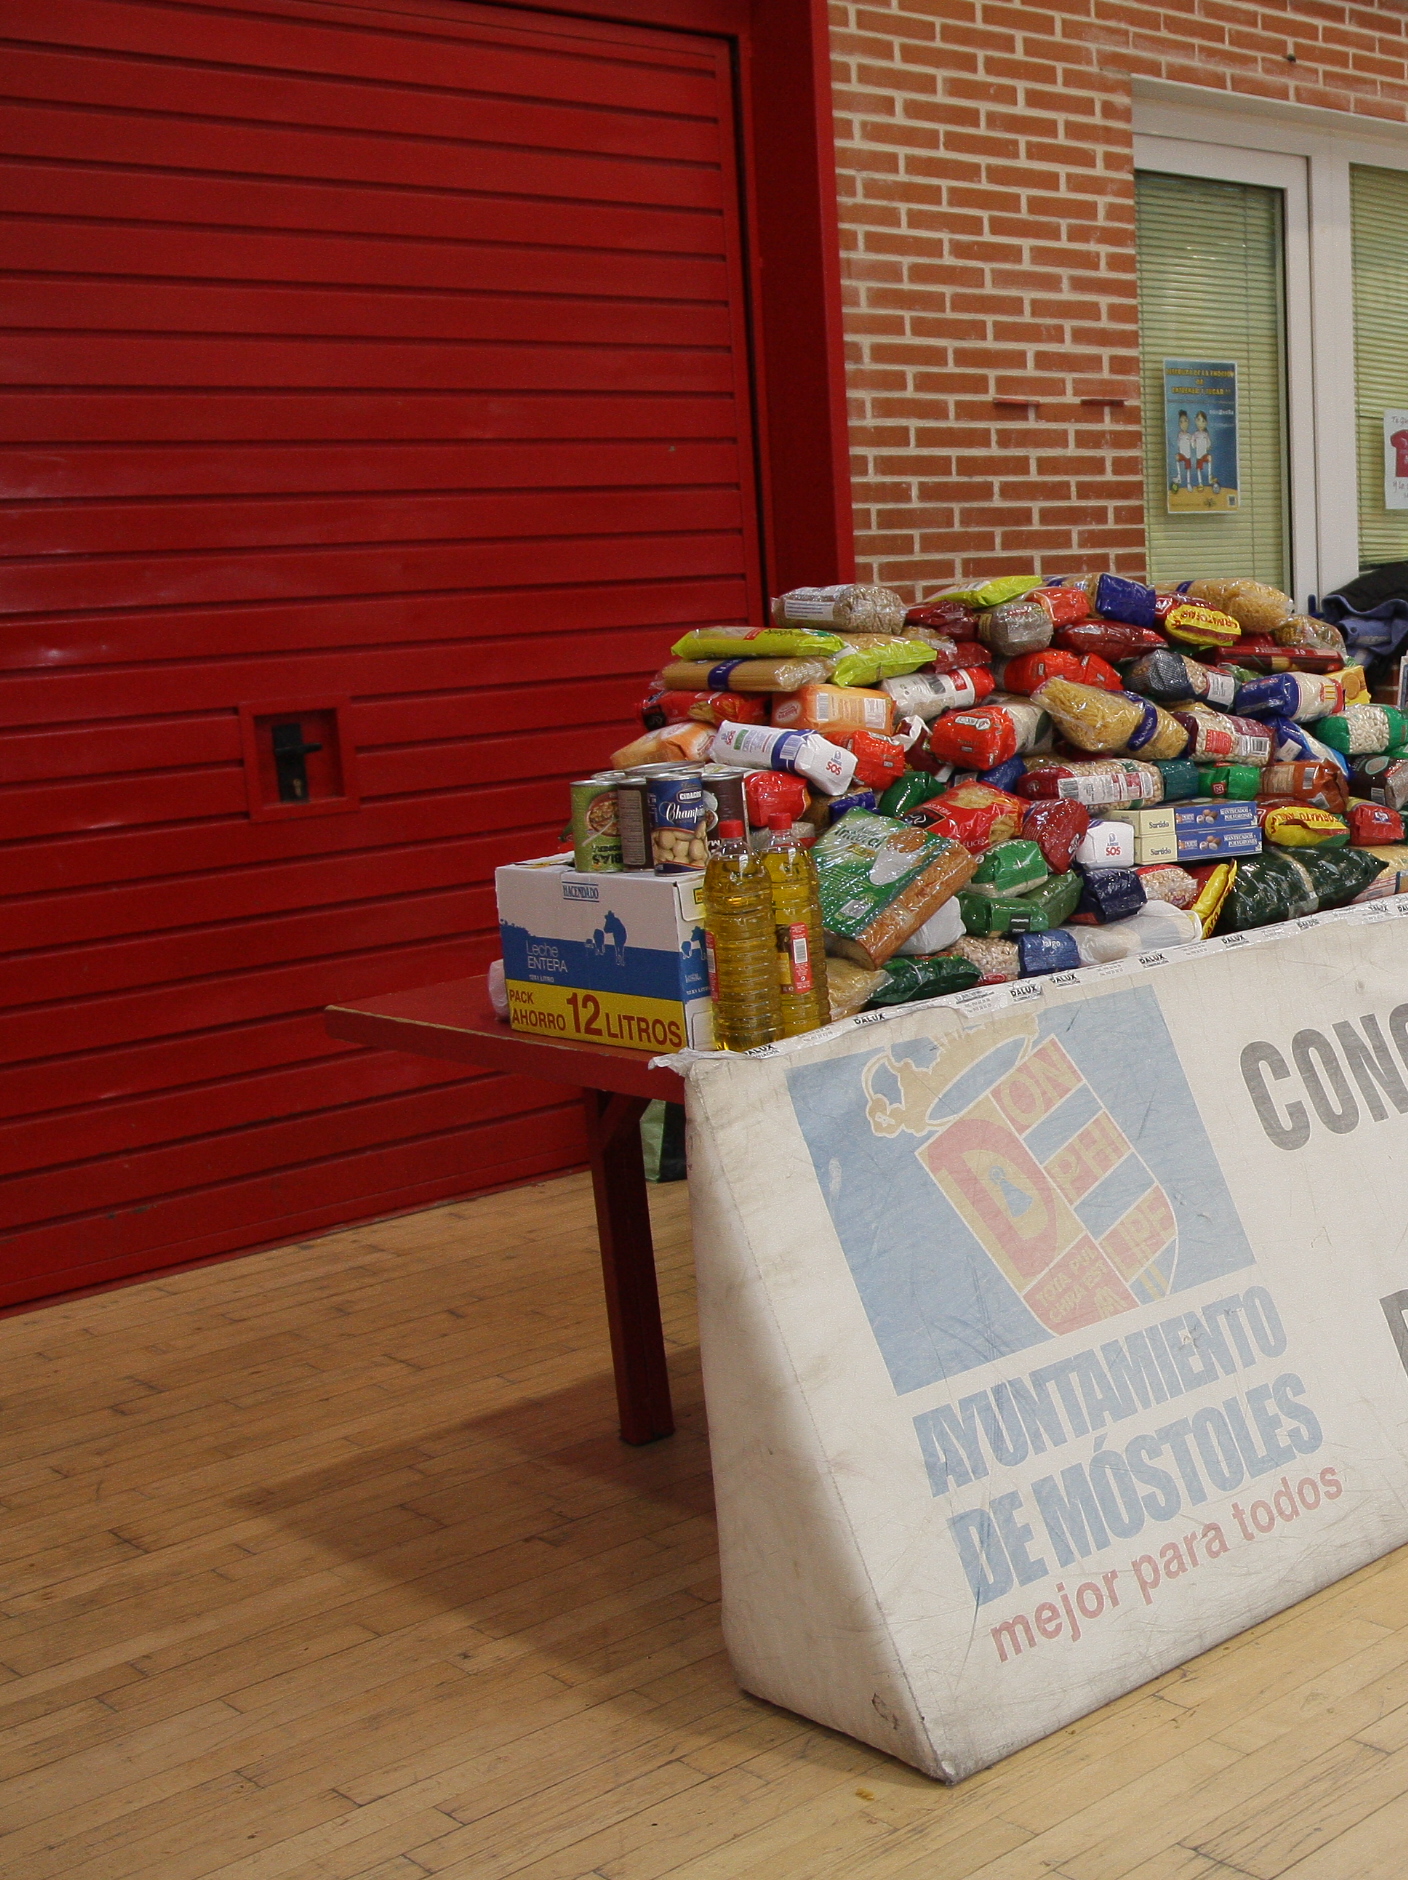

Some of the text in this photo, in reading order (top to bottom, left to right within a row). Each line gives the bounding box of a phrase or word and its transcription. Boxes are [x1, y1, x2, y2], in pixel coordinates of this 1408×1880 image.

[825, 761, 843, 776] SOS
[1149, 822, 1169, 830] Surtido
[1105, 847, 1121, 856] SOS
[1151, 848, 1171, 856] Surtido
[562, 884, 599, 899] HACENDADO
[1221, 935, 1245, 945] DALUX
[525, 940, 559, 958] Leche
[527, 957, 568, 973] ENTERA
[1139, 953, 1166, 964] DALUX
[509, 989, 534, 1005] PACK
[1011, 984, 1037, 997] DALUX
[512, 992, 683, 1048] AHORRO 12 LITROS
[854, 1013, 886, 1025] DALUX
[912, 1285, 1287, 1497] AYUNTAMIENTO
[945, 1373, 1323, 1607] DE MÓSTOLES
[990, 1466, 1343, 1663] mejor para todos
